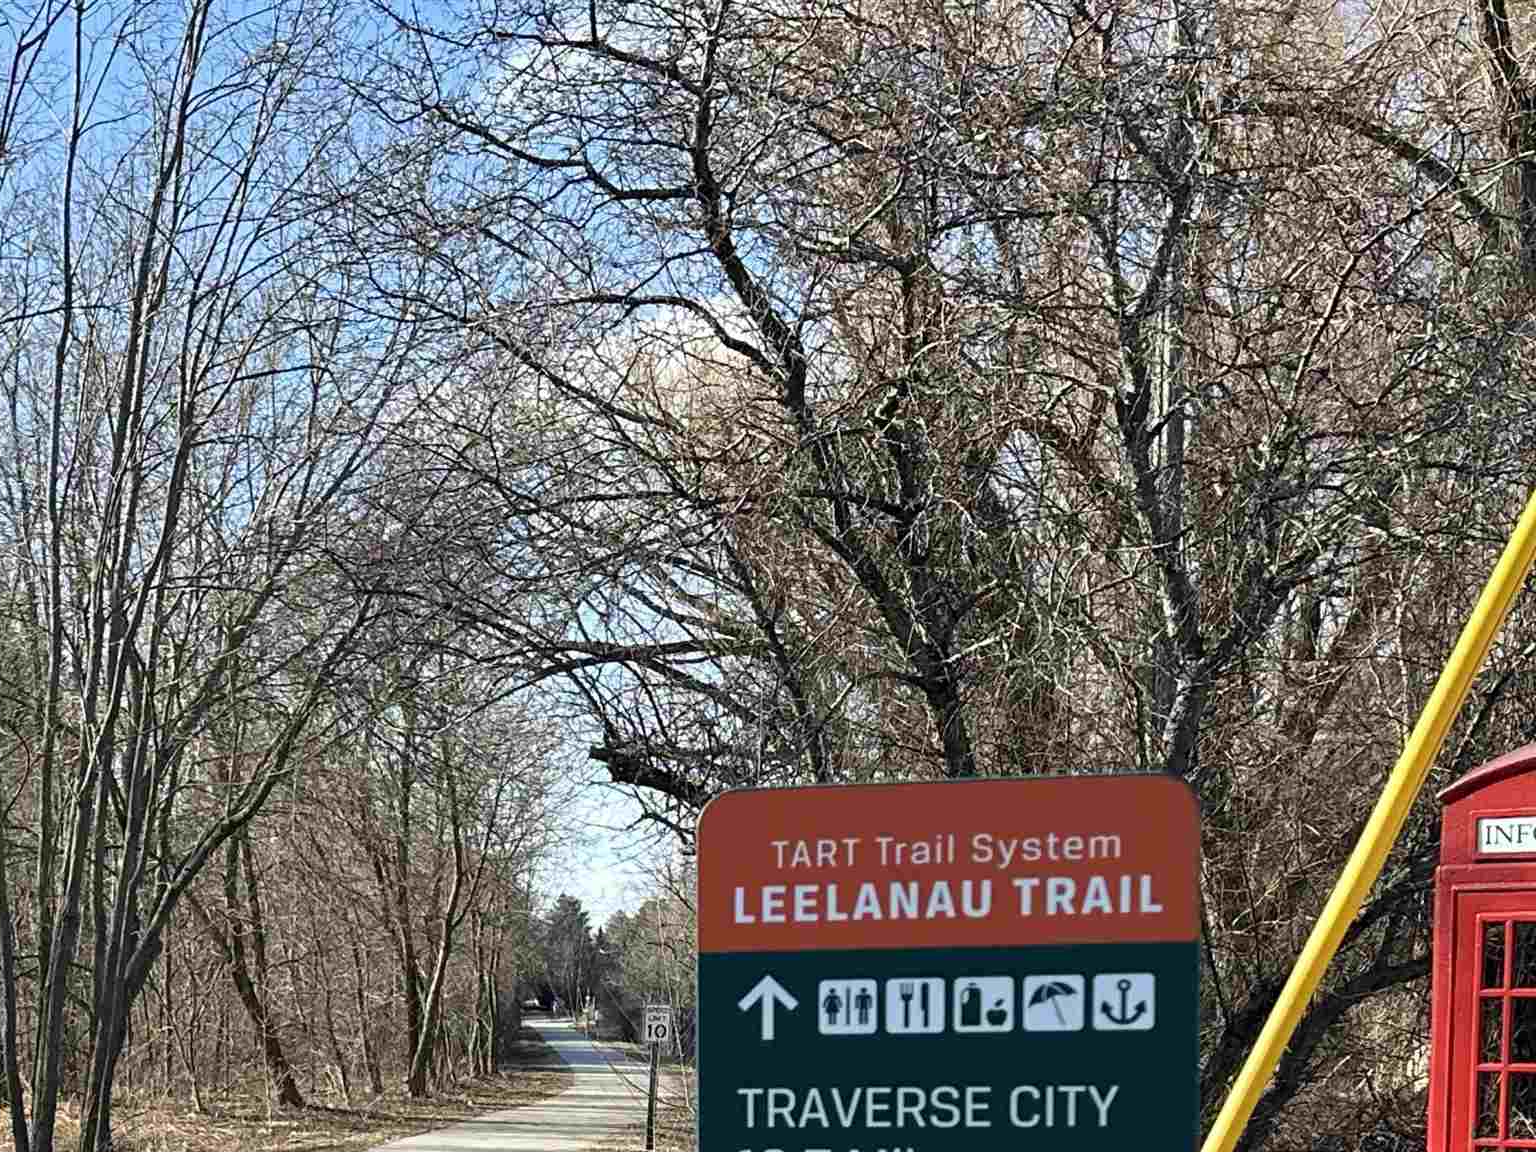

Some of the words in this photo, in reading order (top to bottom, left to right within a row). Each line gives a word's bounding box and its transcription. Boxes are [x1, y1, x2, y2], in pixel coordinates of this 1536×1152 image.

[772, 839, 860, 868] TART
[876, 834, 955, 866] Trail
[972, 832, 1122, 869] System
[733, 879, 993, 924] LEELANAU
[1013, 875, 1164, 916] TRAIL
[647, 1024, 666, 1038] 10
[737, 1087, 992, 1129] TRAVERSE
[1009, 1085, 1120, 1128] CITY
